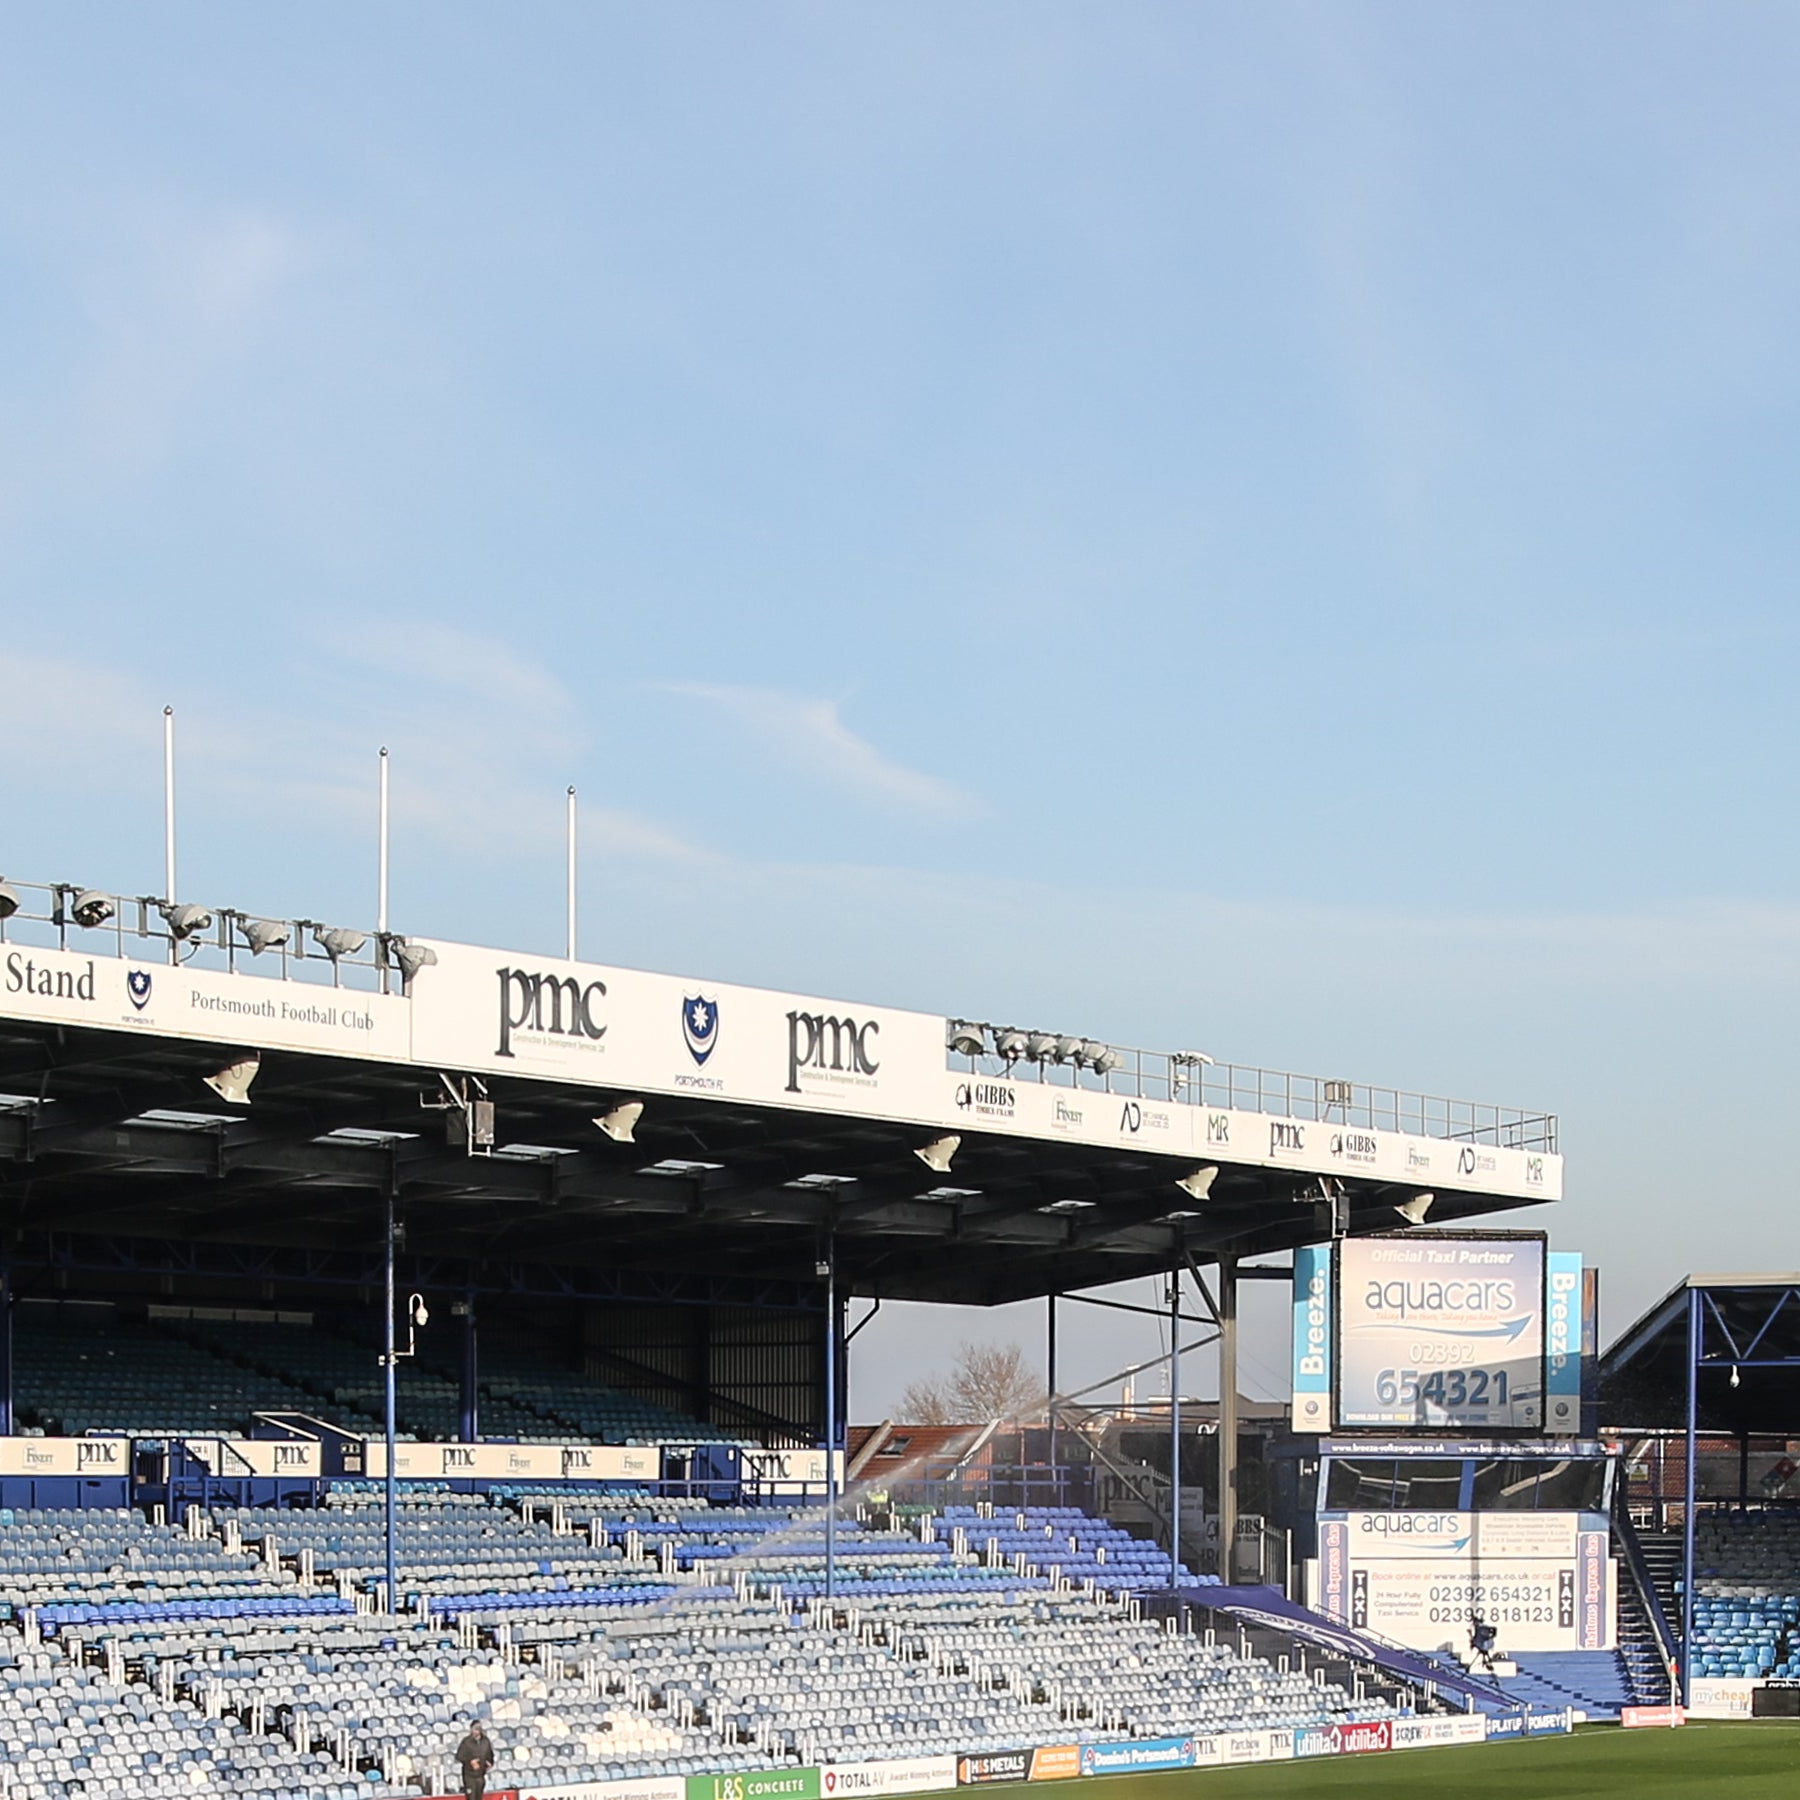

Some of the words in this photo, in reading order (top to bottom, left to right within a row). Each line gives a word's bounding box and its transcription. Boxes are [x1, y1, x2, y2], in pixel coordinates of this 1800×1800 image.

[6, 953, 96, 1001] Stand
[190, 990, 276, 1020] Portsmouth
[281, 1002, 337, 1026] Football
[341, 1008, 374, 1031] Club
[494, 966, 608, 1058] pmc
[784, 1010, 880, 1093] pmc
[975, 1083, 1015, 1107] GIBBS
[1269, 1122, 1305, 1157] pmc
[1346, 1134, 1377, 1153] GIBBS
[1371, 1250, 1422, 1264] Official
[1426, 1250, 1456, 1264] Taxi
[1459, 1251, 1514, 1265] Partner
[1365, 1280, 1513, 1319] aquacars
[1300, 1269, 1326, 1375] Breeze.
[1551, 1271, 1577, 1377] Breeze.
[1409, 1343, 1475, 1364] 02392
[1375, 1369, 1508, 1408] 654321
[76, 1441, 118, 1471] pmc
[273, 1445, 311, 1473] pmc
[441, 1447, 477, 1481] pmc
[560, 1448, 593, 1481] pmc
[749, 1453, 793, 1491] pmc
[1361, 1514, 1459, 1538] aquacars
[1354, 1572, 1366, 1626] TAXI
[1429, 1586, 1486, 1602] 02392
[1489, 1586, 1552, 1602] 654321
[1561, 1572, 1573, 1626] TAXI
[1489, 1608, 1554, 1623] 818123
[1492, 1718, 1509, 1733] PLAY
[1510, 1715, 1522, 1731] UP
[1528, 1713, 1561, 1730] POMPEY
[1131, 1746, 1180, 1763] Portsmouth
[1297, 1732, 1332, 1755] utilita
[1344, 1730, 1379, 1752] utilita
[991, 1756, 1025, 1772] METALS
[747, 1778, 804, 1795] CONCRETE
[839, 1773, 871, 1789] TOTAL
